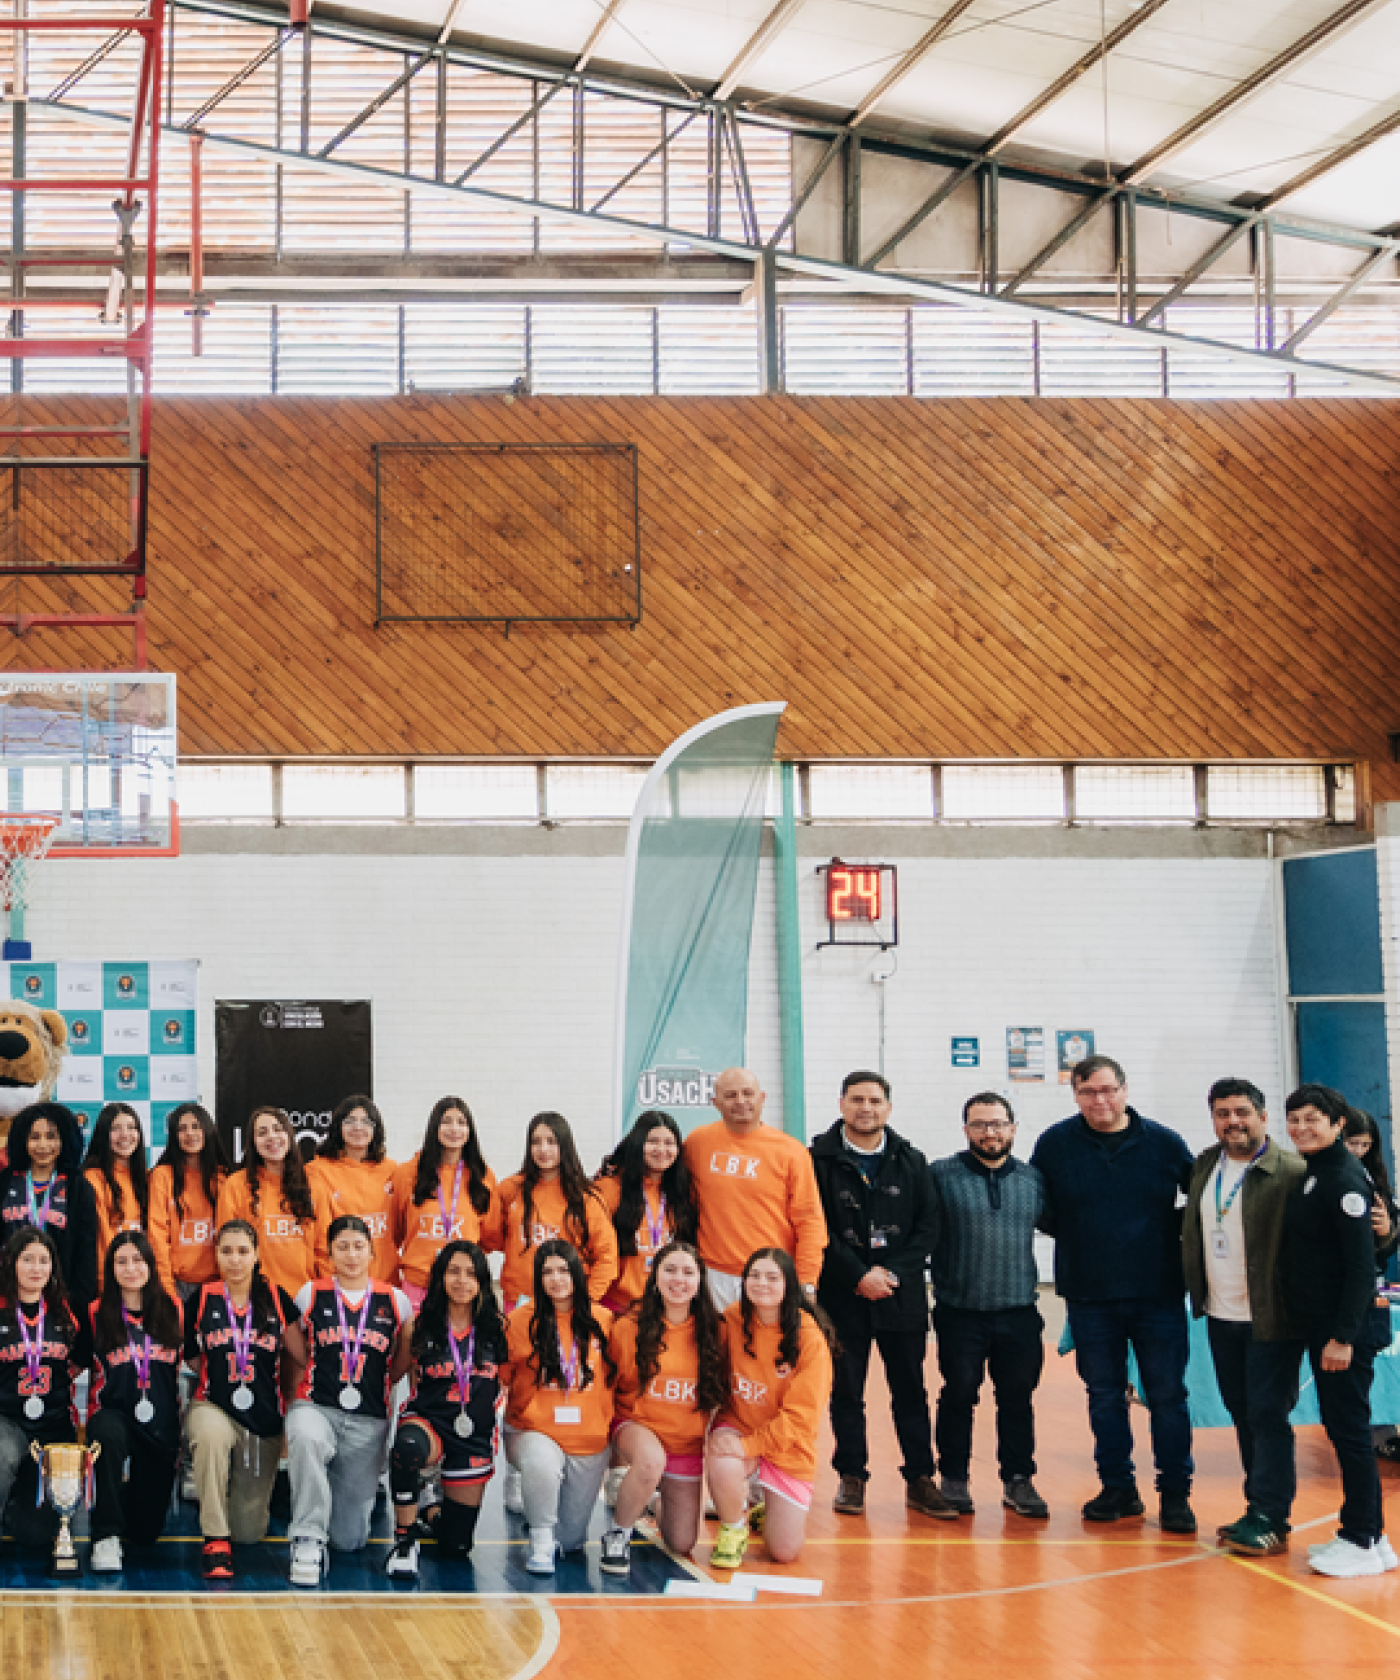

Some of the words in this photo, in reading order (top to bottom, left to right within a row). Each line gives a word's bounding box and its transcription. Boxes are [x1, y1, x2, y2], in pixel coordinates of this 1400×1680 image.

[831, 871, 878, 919] 24
[710, 1152, 760, 1179] LBK
[17, 1366, 52, 1395] 23
[650, 1377, 698, 1400] LBK
